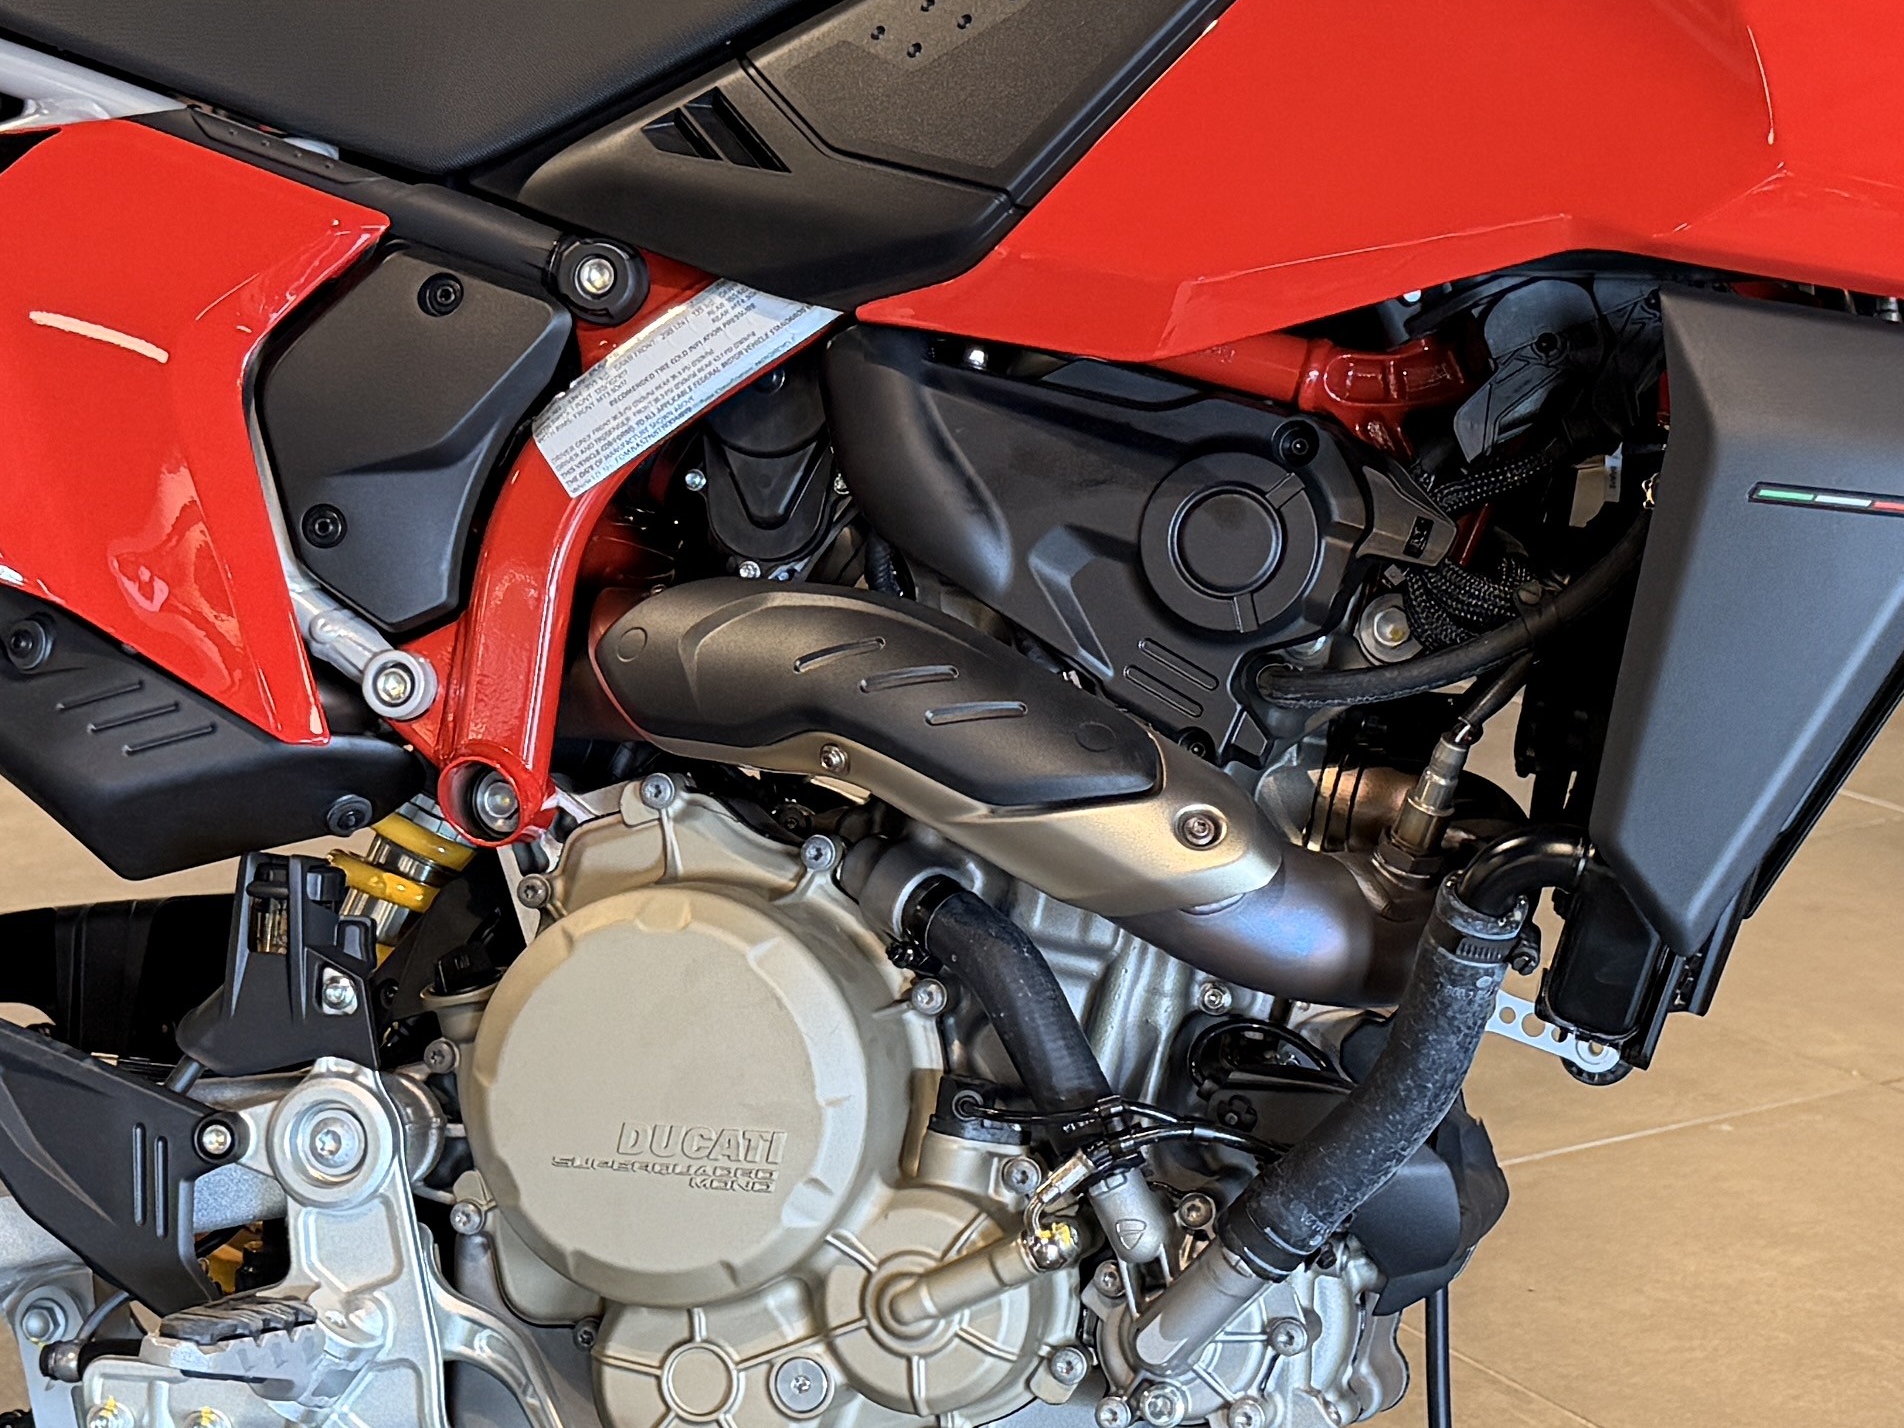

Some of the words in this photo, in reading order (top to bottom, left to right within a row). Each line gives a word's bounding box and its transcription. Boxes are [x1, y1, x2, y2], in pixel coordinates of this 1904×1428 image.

[654, 384, 694, 414] APPLICABLE
[742, 331, 770, 354] VEHICLE
[616, 1122, 788, 1165] DUCATI
[688, 1177, 775, 1194] MONO
